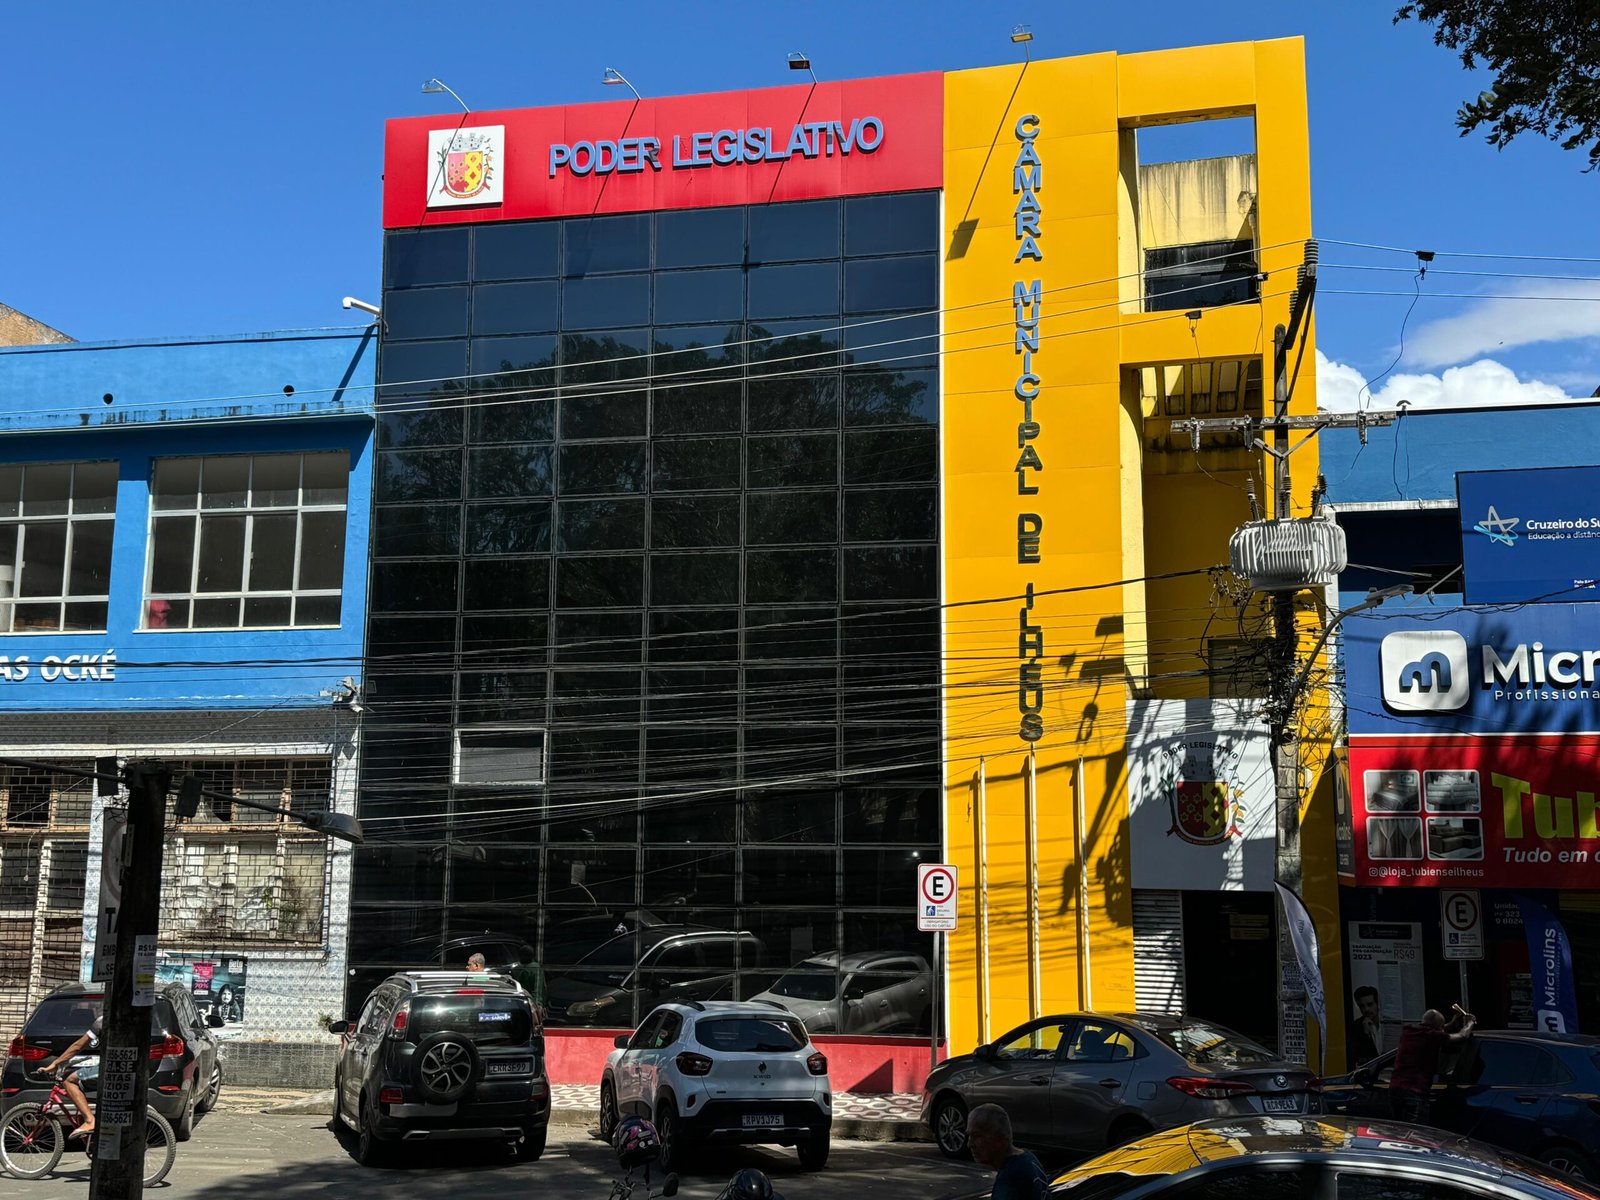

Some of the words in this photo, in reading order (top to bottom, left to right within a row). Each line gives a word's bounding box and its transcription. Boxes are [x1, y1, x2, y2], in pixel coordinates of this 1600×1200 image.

[549, 137, 662, 179] PODER
[672, 116, 884, 170] LEGISLATIVO
[1013, 279, 1043, 495] MUNICIPAL
[1526, 519, 1574, 530] Cruzeiro
[1575, 518, 1589, 528] do
[1017, 513, 1043, 564] DE
[1528, 532, 1565, 540] Educação
[40, 649, 117, 682] OCKÉ
[1163, 743, 1187, 759] PODER
[1503, 847, 1552, 863] Tudo
[1558, 851, 1588, 863] em
[933, 876, 944, 896] E
[1455, 901, 1467, 923] E
[1544, 928, 1557, 1007] Microlins
